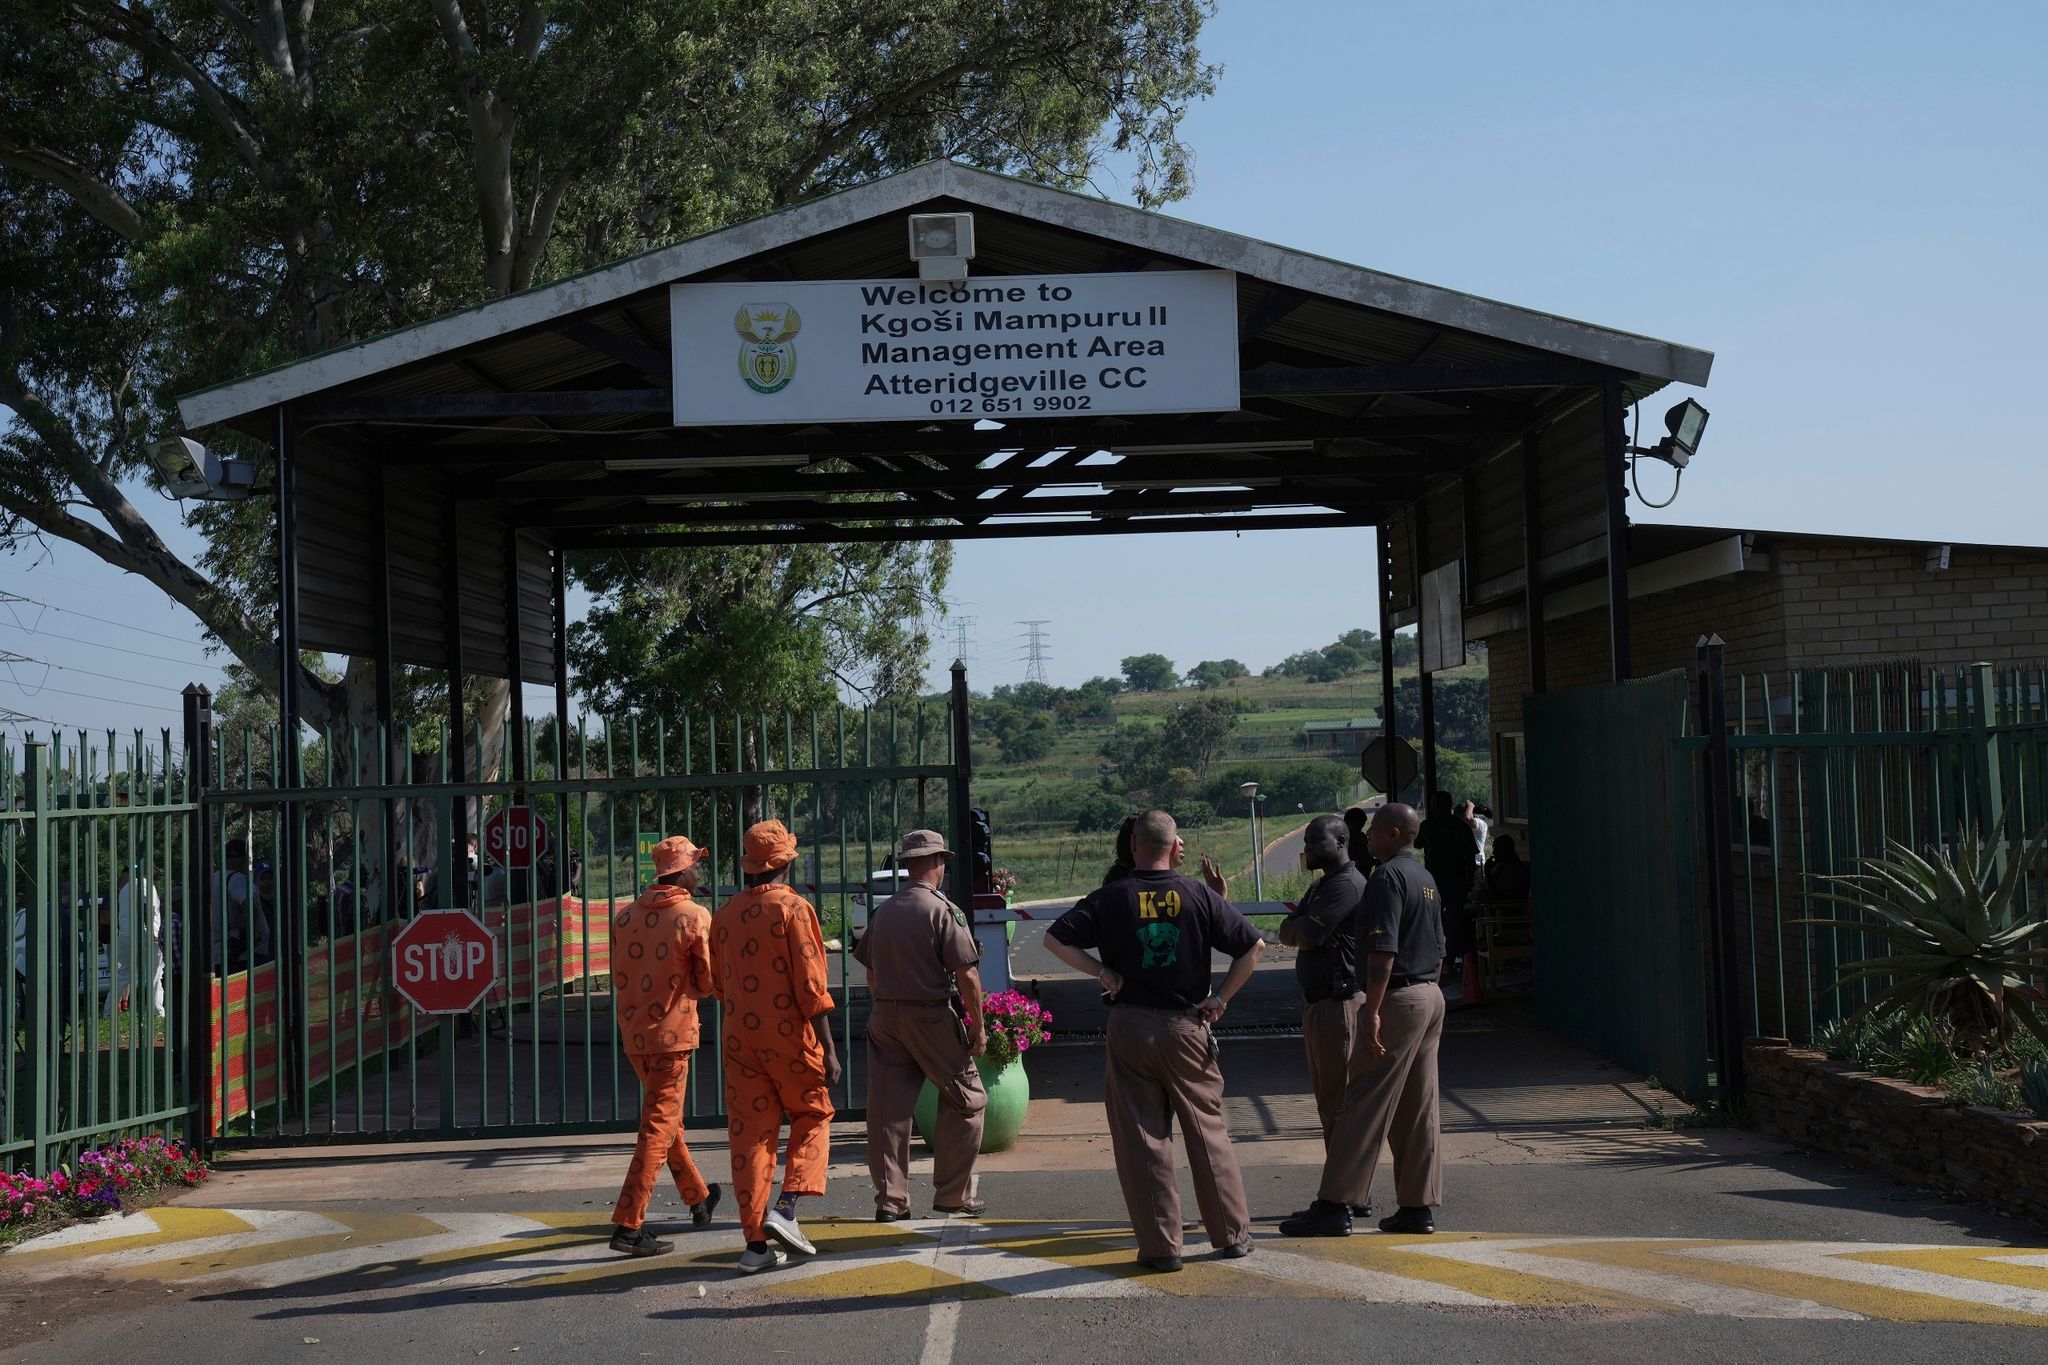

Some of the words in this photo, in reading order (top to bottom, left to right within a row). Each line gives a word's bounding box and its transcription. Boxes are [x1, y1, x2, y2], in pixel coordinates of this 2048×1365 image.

[860, 284, 1026, 306] Welcome
[1037, 282, 1073, 302] to
[861, 309, 963, 338] Kgoši
[861, 337, 1078, 367] Management
[1086, 335, 1165, 358] Area
[863, 369, 1087, 398] Atteridgeville
[1098, 366, 1147, 389] CC
[930, 398, 973, 414] 012
[981, 397, 1022, 413] 651
[1033, 395, 1092, 411] 9902
[1137, 889, 1182, 919] K-9
[404, 941, 486, 983] STOP
